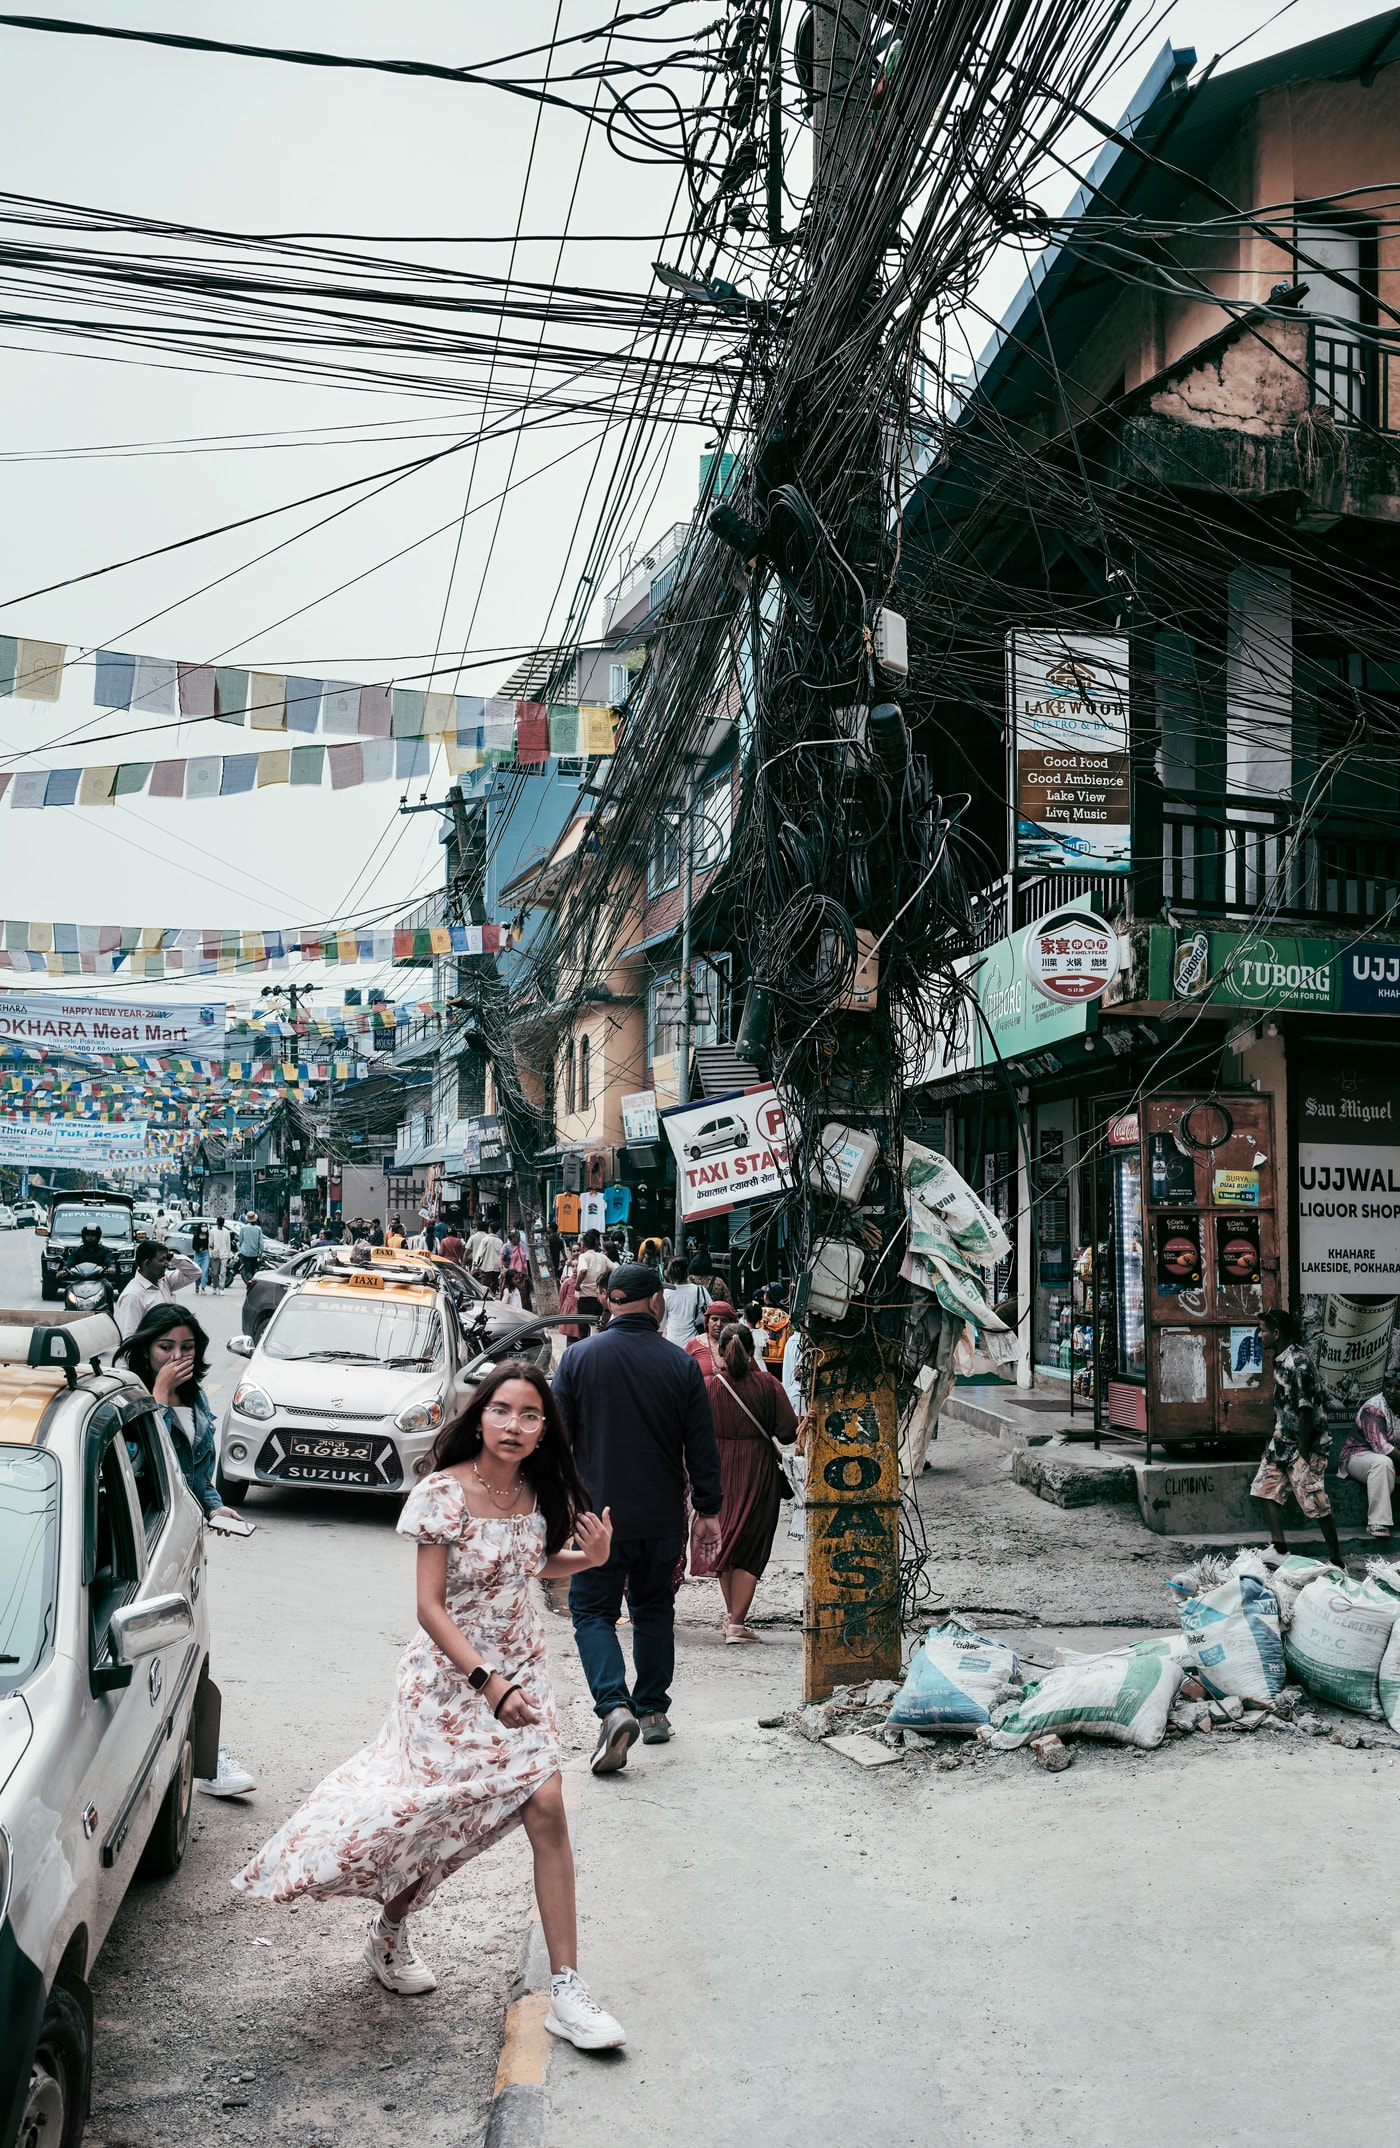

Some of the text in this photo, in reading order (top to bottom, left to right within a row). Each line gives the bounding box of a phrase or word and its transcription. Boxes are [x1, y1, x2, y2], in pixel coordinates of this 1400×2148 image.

[1025, 700, 1124, 717] LAKEWOOD
[1033, 719, 1077, 729] RESTRO
[1081, 720, 1090, 730] &
[1043, 756, 1109, 769] Good Food
[1027, 772, 1124, 786] Good Ambience
[1046, 790, 1106, 803] Lake View
[1045, 807, 1107, 820] Live Music
[1041, 958, 1107, 967] 川菜 火锅 烧烤
[1176, 946, 1205, 991] TUBORG
[1353, 955, 1400, 982] UJJ
[1239, 959, 1330, 992] TUBORG
[987, 979, 1022, 1021] TUBORG
[1279, 990, 1330, 1001] OPEN FOR FUN
[62, 1006, 93, 1016] HAPPY
[95, 1008, 116, 1017] NEW
[93, 1022, 139, 1040] Meat
[146, 1025, 188, 1042] Mart
[1305, 1097, 1393, 1123] San Miguel
[765, 1108, 788, 1136] P
[1, 1126, 53, 1136] Third Pole
[59, 1129, 142, 1139] Tuki Resort
[686, 1143, 798, 1187] TAXI STAN
[1225, 1174, 1249, 1183] SURYA
[1300, 1166, 1400, 1193] UJJWAL
[95, 1211, 126, 1220] POLICE
[1300, 1202, 1400, 1219] LIQUOR SHOP
[375, 1248, 393, 1257] TAXI
[1328, 1248, 1376, 1259] KHAHARE
[1301, 1262, 1400, 1274] LAKESIDE, POKHARA
[353, 1275, 379, 1287] TAXI
[317, 1302, 410, 1318] SAHIL CAB
[1320, 1321, 1391, 1365] San Miguel
[287, 1466, 369, 1483] SUZUKI
[1165, 1475, 1215, 1496] CLIMBING
[1332, 1614, 1379, 1635] CEMENT
[1310, 1627, 1347, 1649] P.P.C
